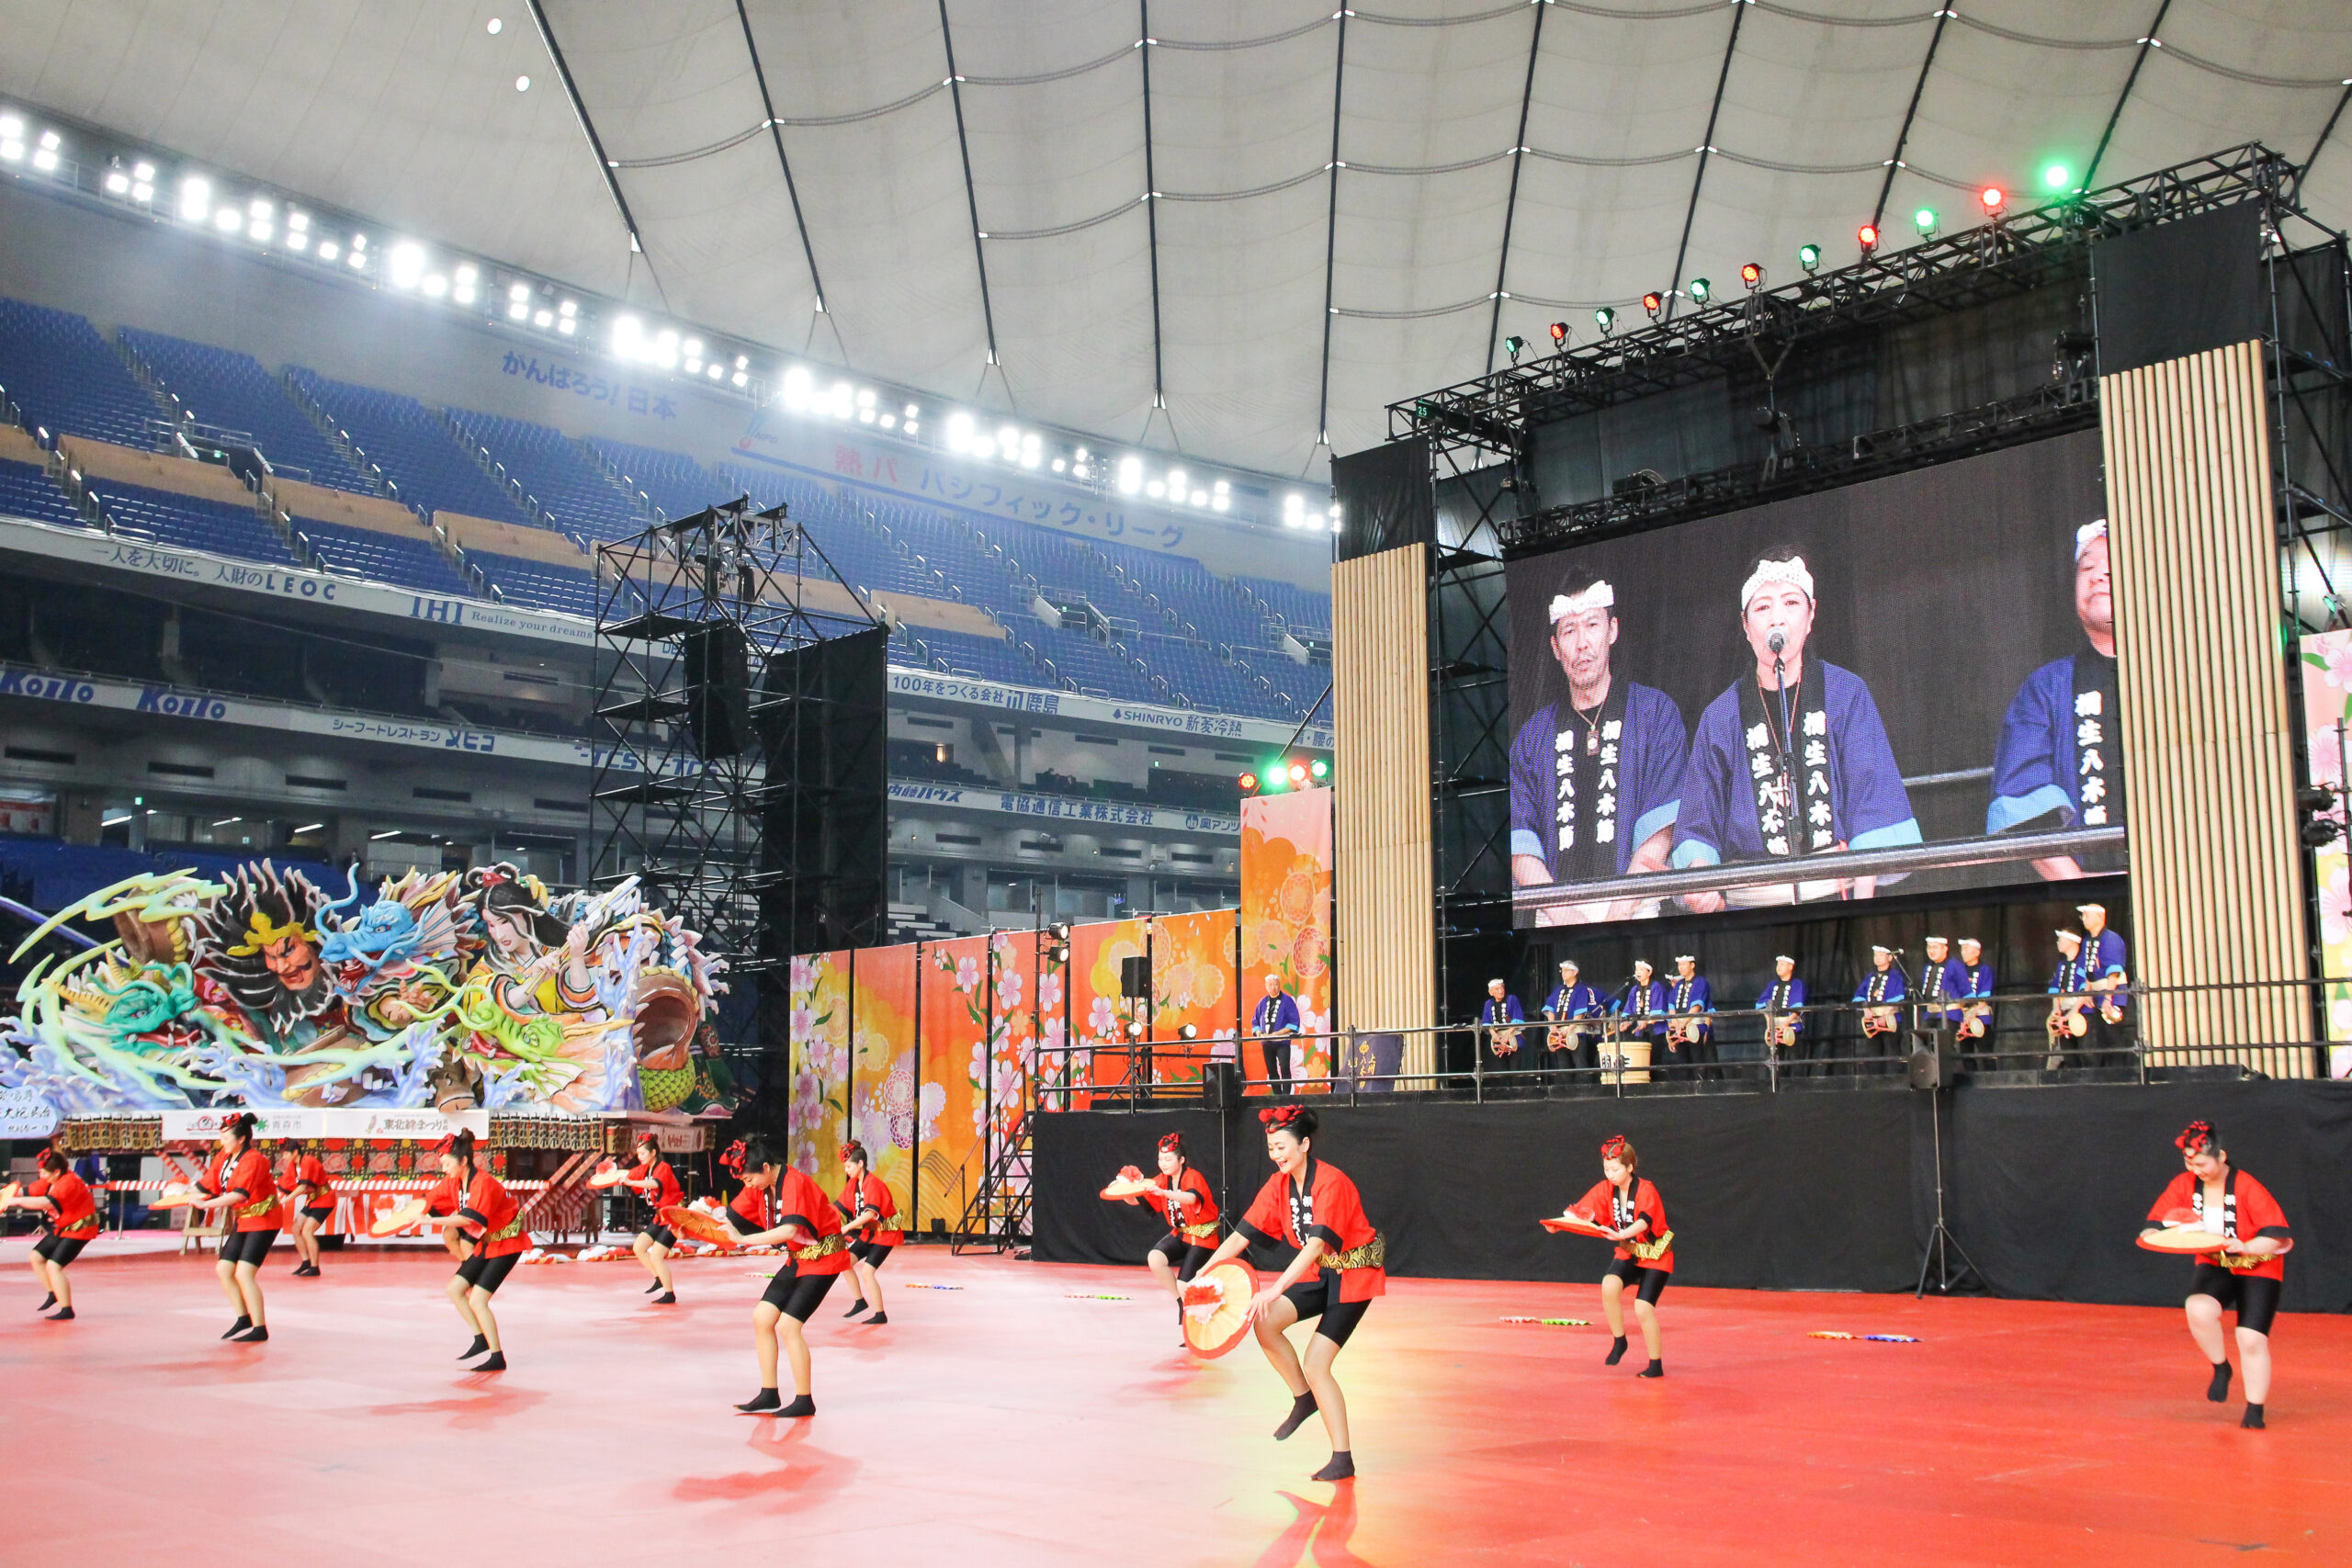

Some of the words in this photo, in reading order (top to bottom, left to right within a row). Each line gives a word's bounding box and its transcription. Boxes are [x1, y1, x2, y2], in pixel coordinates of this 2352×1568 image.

[628, 387, 677, 420] 日本
[1418, 406, 1428, 416] 25
[409, 596, 464, 625] IHI
[471, 610, 516, 626] Realize
[518, 620, 548, 633] your
[549, 624, 594, 638] dreams
[893, 675, 1003, 705] 100年をつくる会社
[1026, 692, 1059, 716] 鹿島
[1123, 710, 1183, 728] SHINRYO
[333, 718, 441, 742] シーフードレストラン
[446, 728, 495, 752] メヒコ
[1001, 794, 1154, 826] 電協通信工業株式会社
